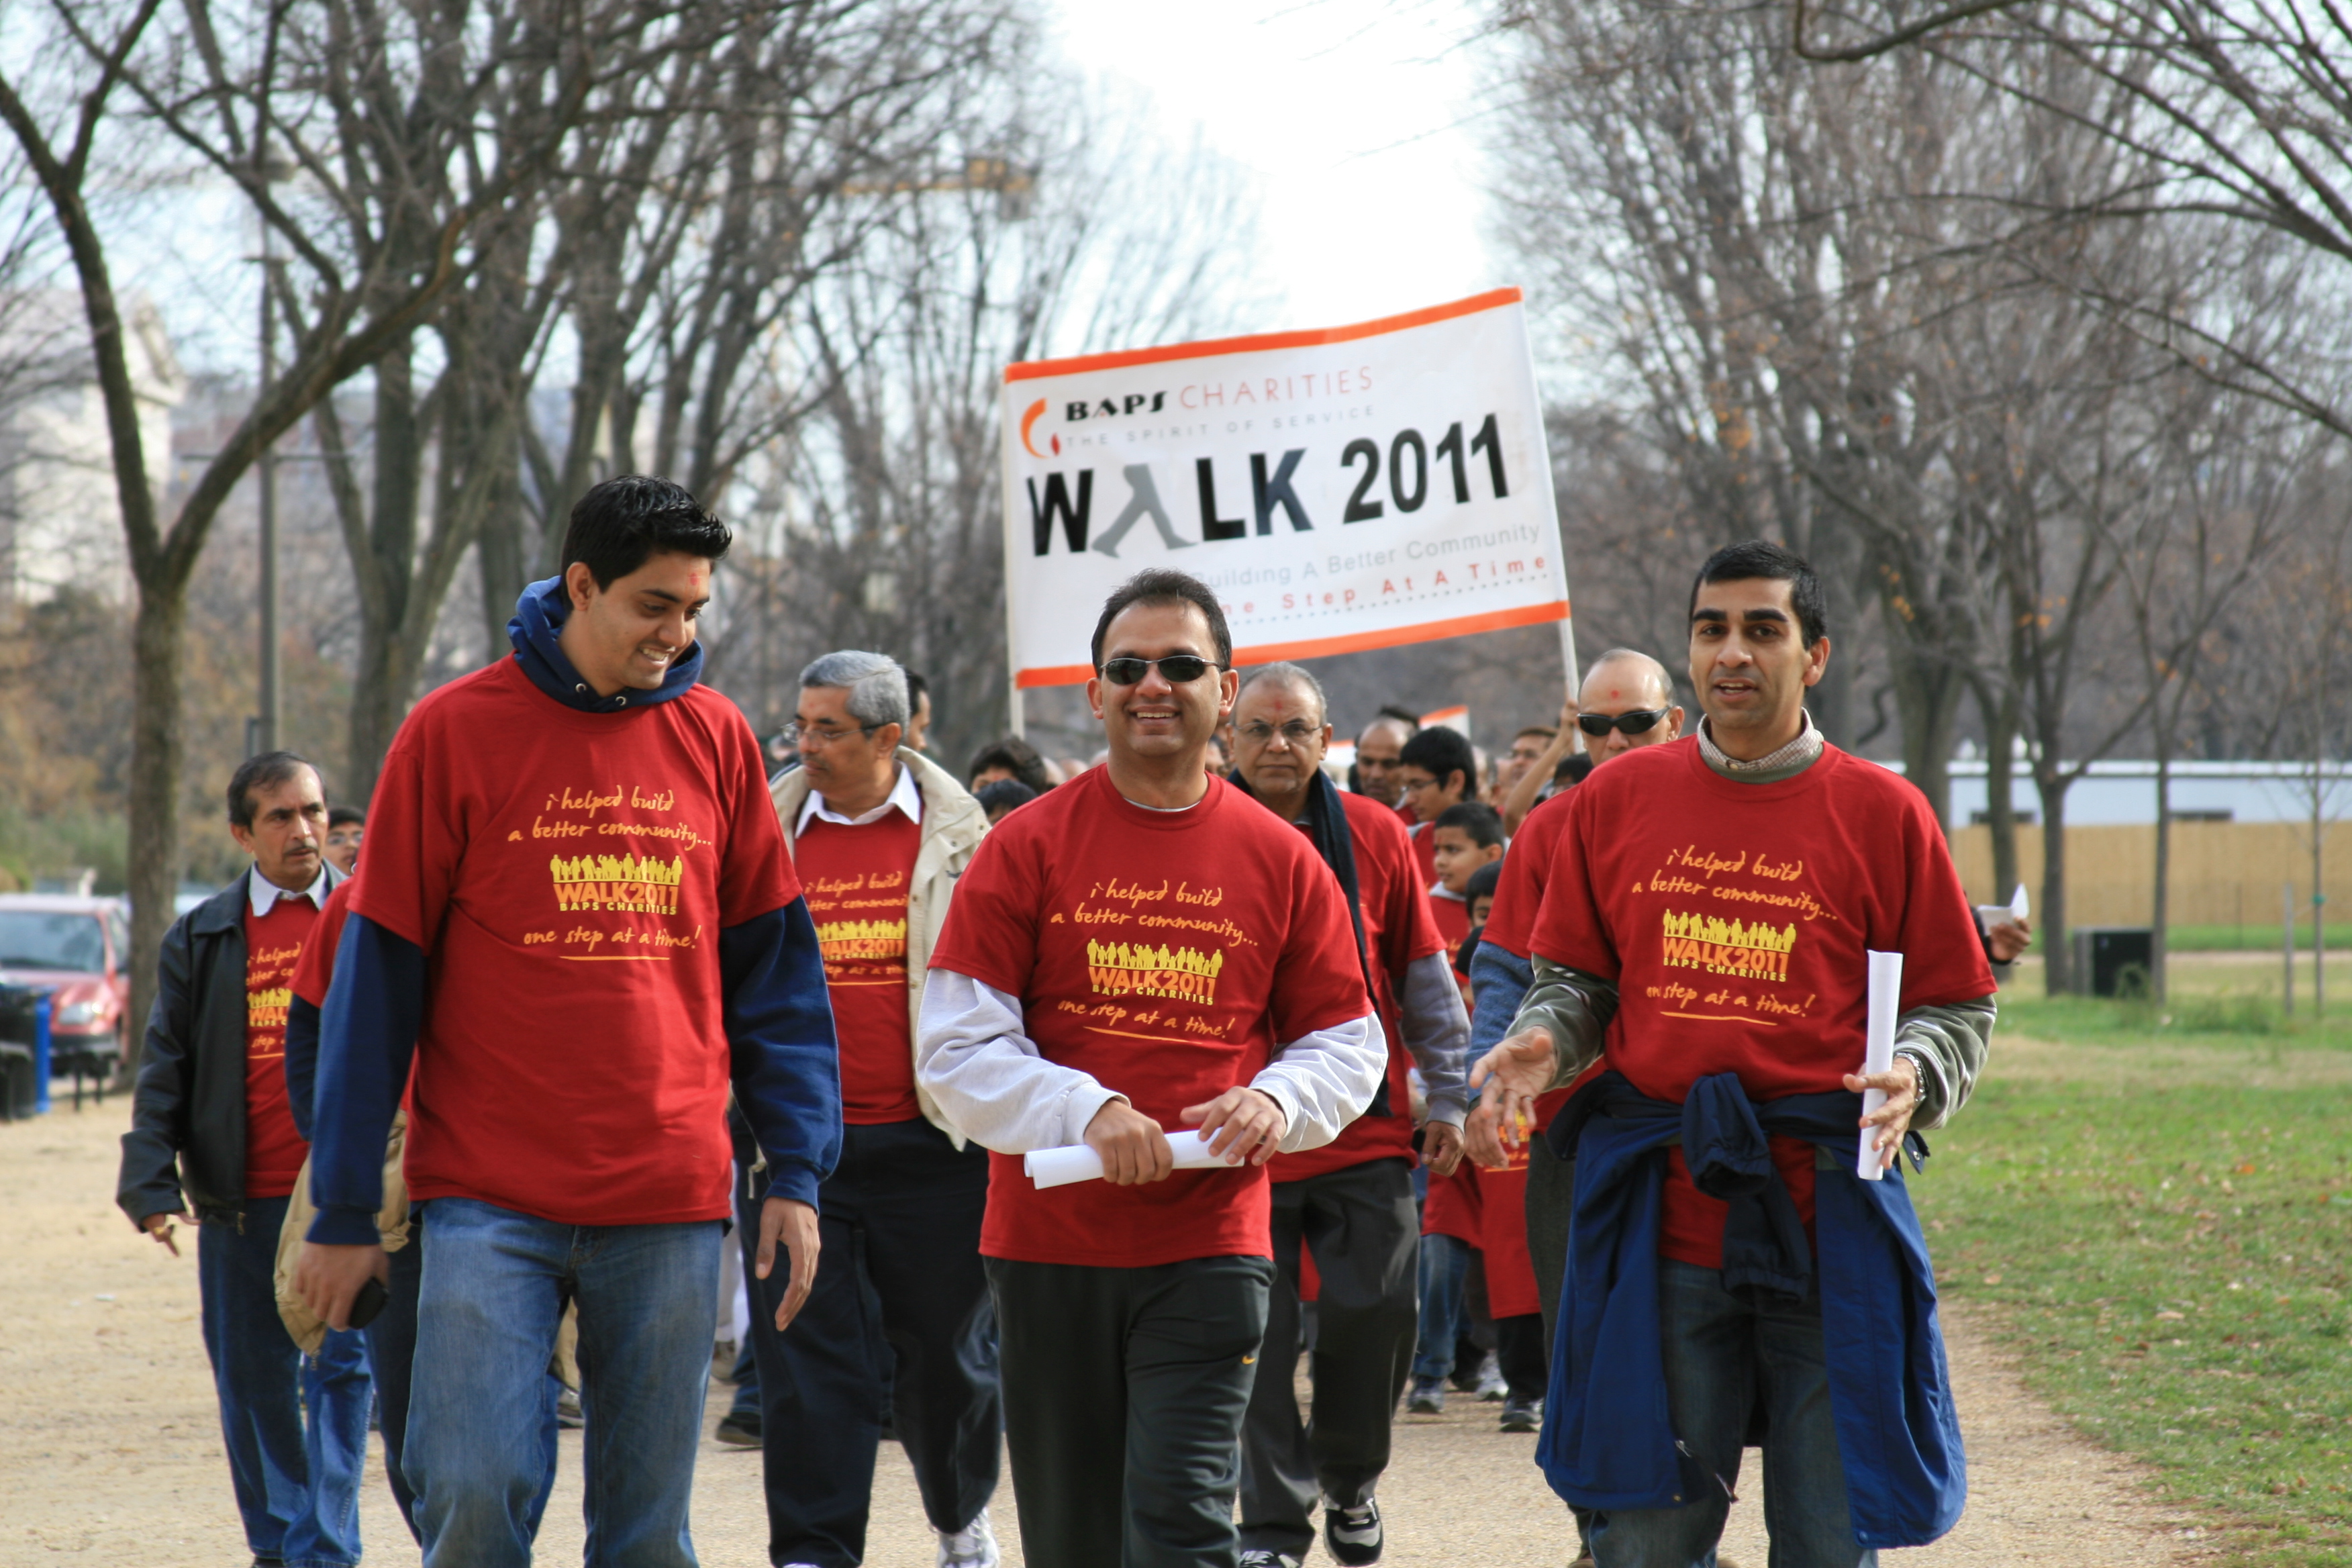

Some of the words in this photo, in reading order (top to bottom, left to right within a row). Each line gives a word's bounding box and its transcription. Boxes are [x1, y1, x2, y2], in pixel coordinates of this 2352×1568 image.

[1065, 391, 1168, 422] BAPS
[1179, 366, 1373, 408] CHARITIES
[1067, 436, 1109, 448] THE
[1127, 424, 1208, 442] SPIRIT
[1228, 420, 1254, 434] OF
[1273, 405, 1375, 429] SERVICE
[1026, 446, 1314, 559] WALK
[1340, 412, 1510, 524] 2011
[1304, 561, 1318, 579] A
[1328, 548, 1397, 573] Better
[1406, 524, 1540, 559] Community
[1220, 601, 1255, 615] ne
[1282, 588, 1356, 609] Step
[1382, 577, 1414, 595] At
[1435, 570, 1449, 586] A
[1469, 556, 1545, 579] Time
[561, 785, 623, 818] helped
[631, 785, 675, 811] build
[507, 830, 524, 842] a
[532, 816, 593, 838] better
[1681, 844, 1746, 879] helped
[1752, 853, 1803, 881] build
[553, 882, 679, 906] WALK2011
[816, 873, 864, 898] helped
[868, 871, 903, 889] build
[1106, 878, 1168, 908] helped
[1176, 881, 1222, 906] build
[1632, 881, 1643, 893] a
[1650, 869, 1707, 895] better
[559, 901, 600, 912] BAPS
[606, 901, 677, 915] CHARITIES
[809, 899, 838, 912] tter
[1050, 913, 1065, 924] a
[1074, 902, 1133, 924] better
[524, 930, 557, 945] one
[564, 926, 603, 952] step
[611, 927, 636, 943] at
[638, 933, 650, 944] a
[654, 925, 702, 948] time!
[256, 941, 301, 966] helped
[1663, 937, 1789, 974] WALK2011
[246, 971, 277, 986] etter
[1088, 966, 1216, 997] WALK2011
[1706, 963, 1787, 983] CHARITIES
[1136, 986, 1214, 1006] CHARITIES
[1663, 981, 1698, 1009] step
[1704, 989, 1730, 1005] at
[1734, 996, 1749, 1007] a
[1755, 993, 1816, 1018] time!
[1057, 999, 1087, 1015] one
[1089, 1000, 1127, 1026] step
[1134, 1011, 1161, 1025] at
[1163, 1018, 1177, 1028] a
[1184, 1016, 1236, 1039] time!
